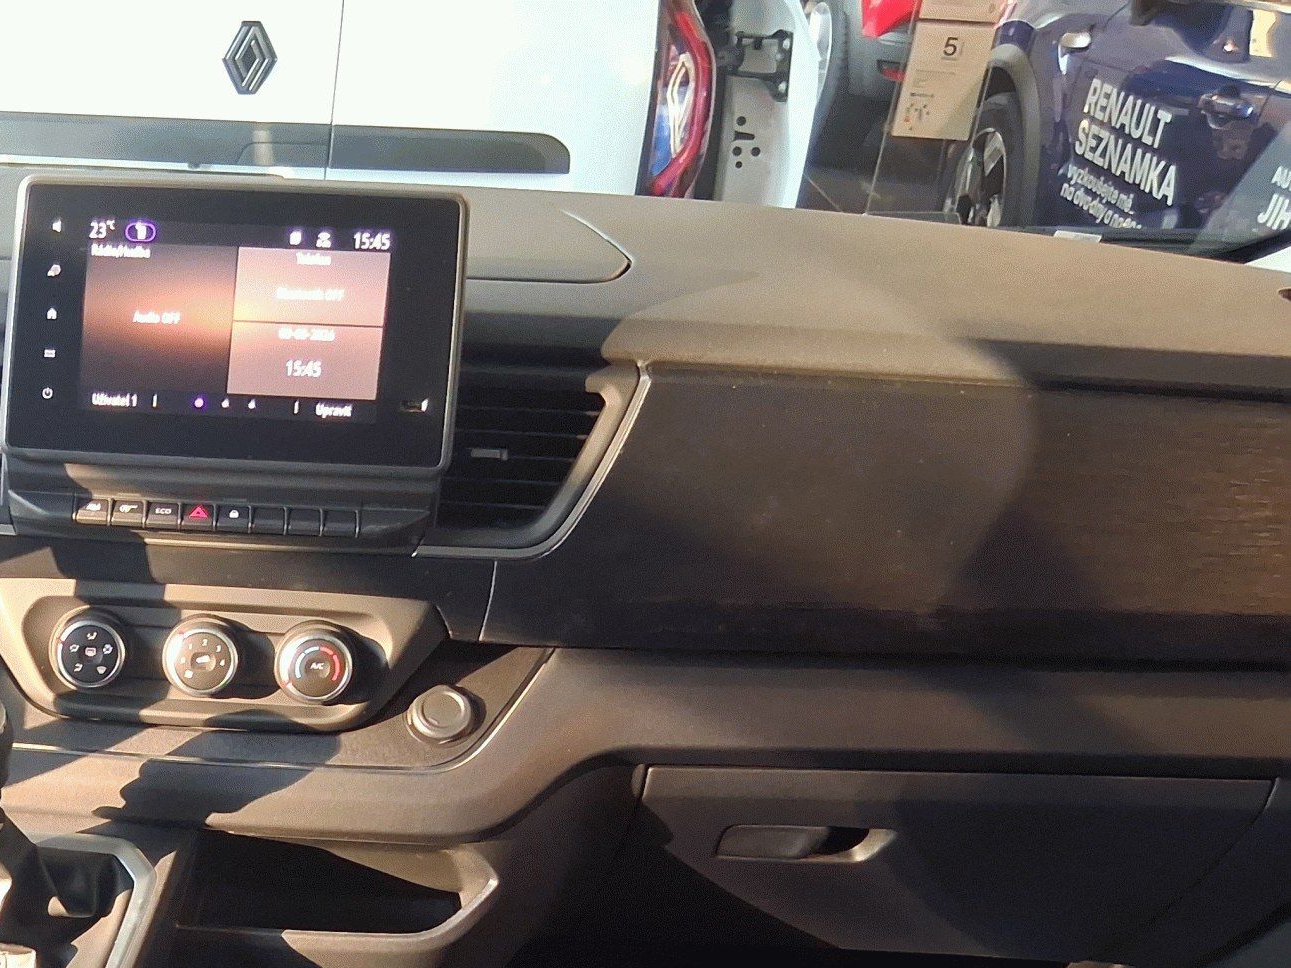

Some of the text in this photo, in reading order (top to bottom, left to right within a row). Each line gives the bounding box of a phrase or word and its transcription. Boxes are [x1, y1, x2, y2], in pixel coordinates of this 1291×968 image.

[943, 36, 959, 56] 5
[1083, 78, 1173, 149] RENAULT
[1074, 118, 1177, 206] SEZNAMKA
[353, 231, 391, 250] 15:45
[286, 359, 322, 378] 15:45
